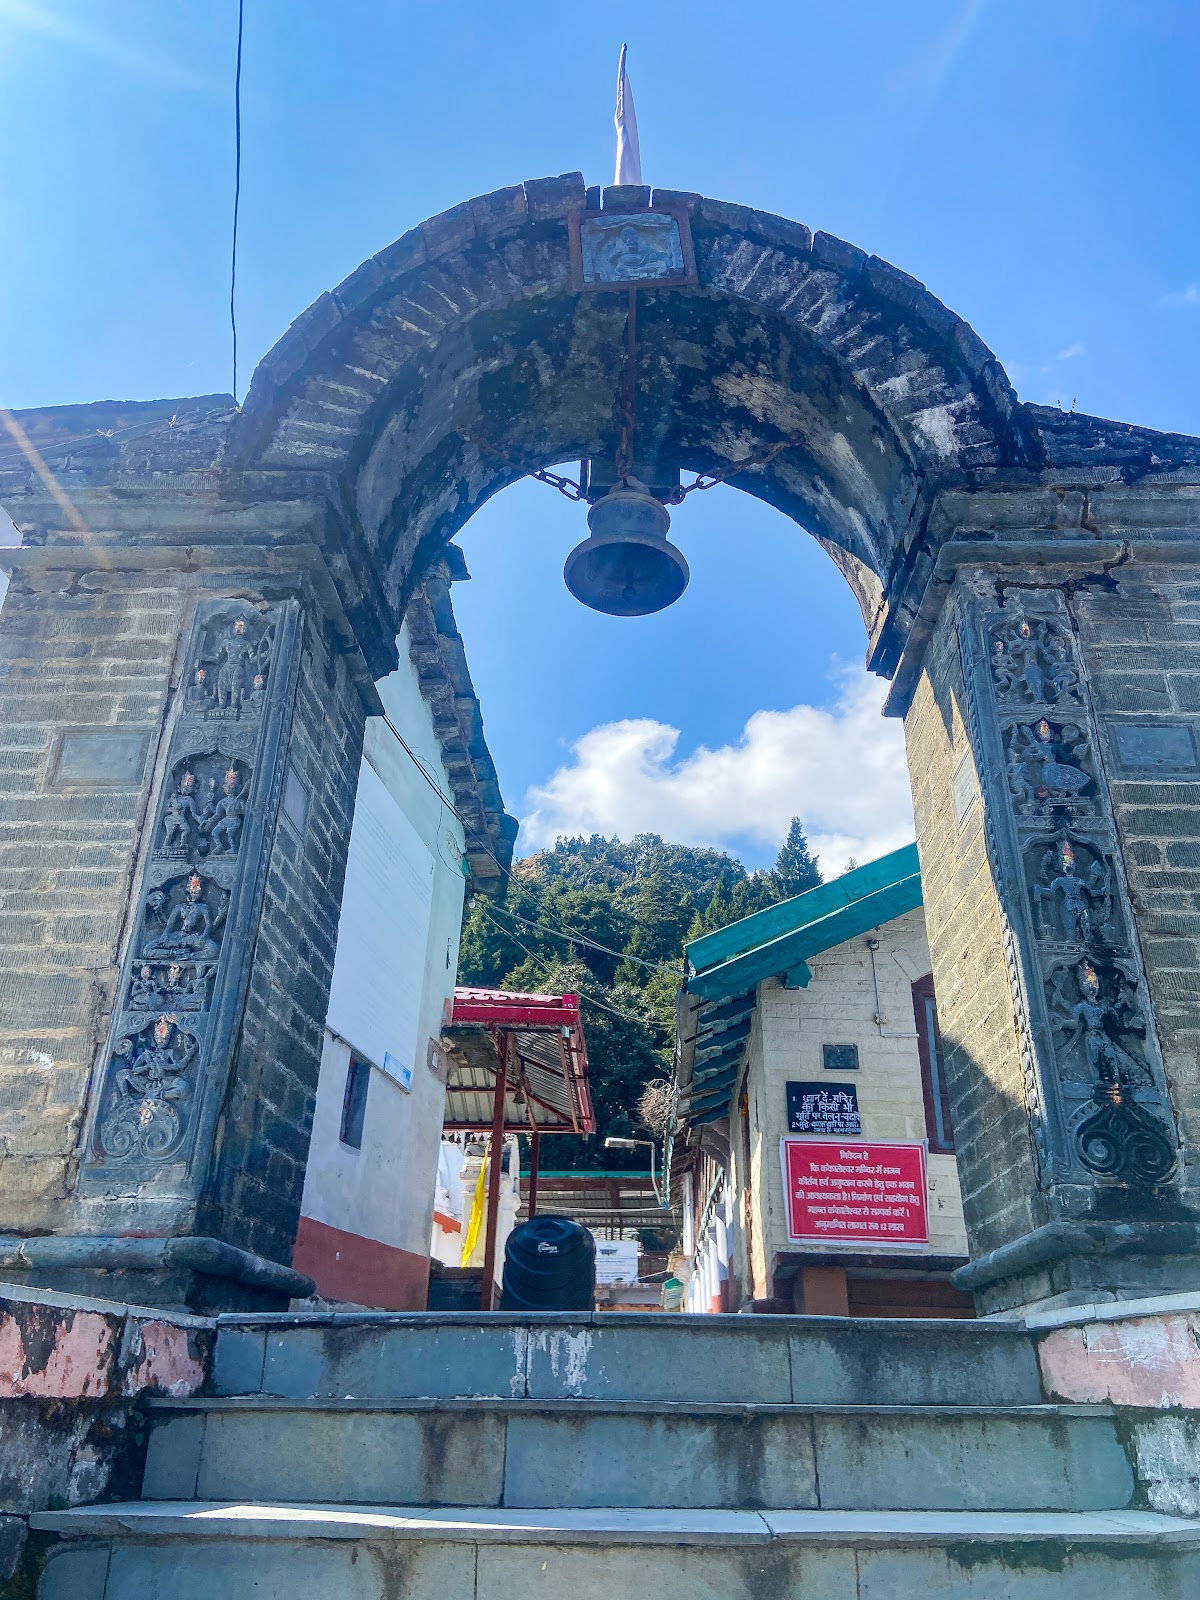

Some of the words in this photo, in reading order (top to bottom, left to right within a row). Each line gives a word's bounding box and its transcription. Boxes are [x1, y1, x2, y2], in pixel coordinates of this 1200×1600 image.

[817, 1101, 840, 1111] किसी
[843, 1102, 854, 1112] भी
[812, 1112, 822, 1120] पर
[840, 1150, 862, 1159] निवेदन
[863, 1151, 868, 1160] है
[810, 1163, 820, 1171] कि
[856, 1164, 875, 1174] मन्दिर
[884, 1167, 900, 1175] भजन
[798, 1176, 818, 1185] कीर्तन
[819, 1176, 829, 1186] एवं
[856, 1179, 873, 1188] करने
[874, 1179, 885, 1190] हेतु
[898, 1181, 914, 1189] भवन
[795, 1190, 804, 1199] की
[806, 1192, 841, 1200] आवश्यकता
[851, 1191, 872, 1201] निर्माण
[874, 1192, 883, 1202] एवं
[884, 1193, 908, 1202] सहयोग
[909, 1194, 920, 1206] हेतु
[807, 1206, 826, 1214] महन्त
[862, 1206, 869, 1215] से
[870, 1206, 892, 1216] सम्पर्क
[814, 1219, 846, 1231] अनुमानित
[846, 1222, 867, 1230] लागत
[888, 1223, 904, 1231] लाख
